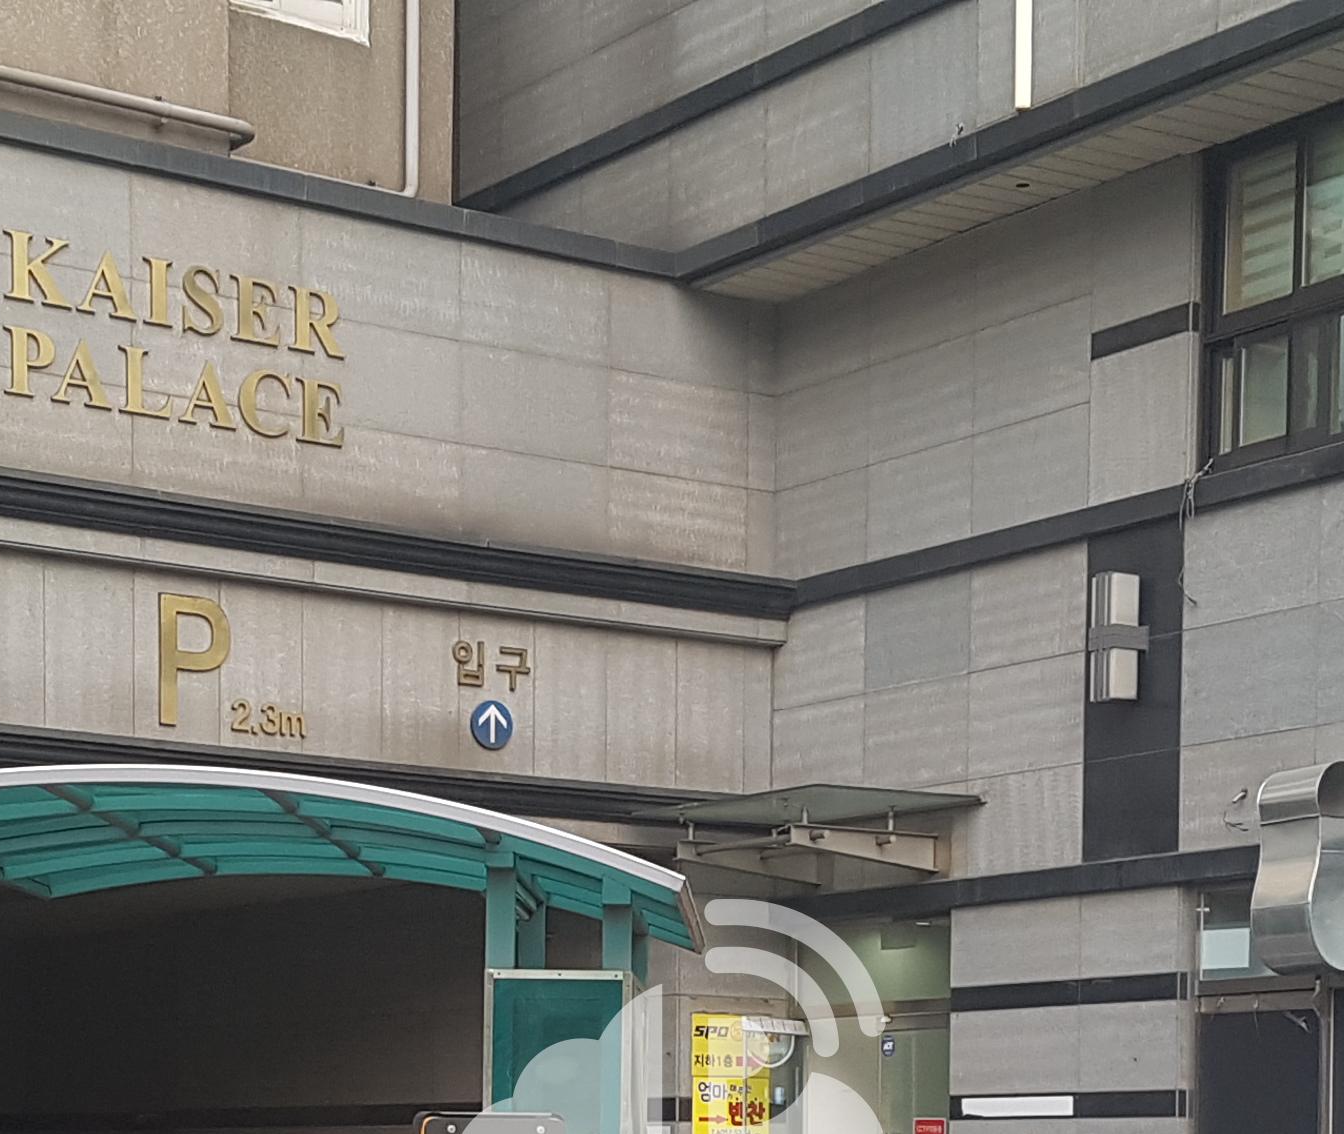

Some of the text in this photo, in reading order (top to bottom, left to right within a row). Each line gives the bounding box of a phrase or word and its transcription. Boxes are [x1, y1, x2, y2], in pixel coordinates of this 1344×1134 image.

[2, 228, 344, 360] KAISER
[3, 324, 345, 448] PALACE
[158, 592, 306, 740] P 2.3m
[452, 639, 531, 691] 입구
